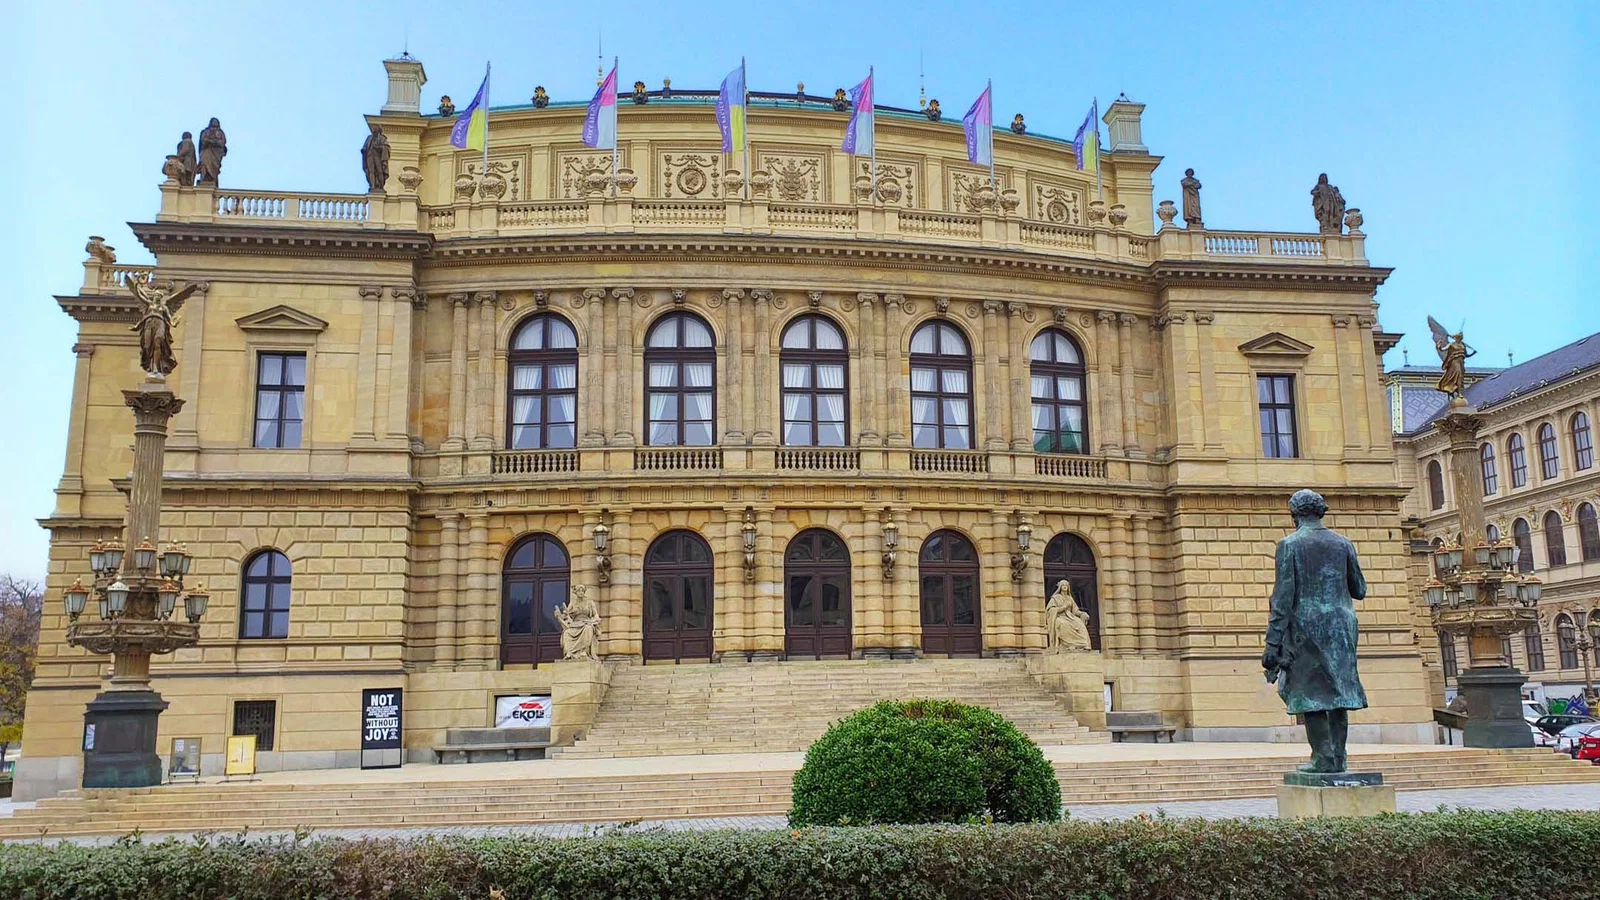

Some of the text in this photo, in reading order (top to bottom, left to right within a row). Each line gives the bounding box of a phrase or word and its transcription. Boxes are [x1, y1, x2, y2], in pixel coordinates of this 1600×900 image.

[371, 694, 394, 706] NOT
[366, 718, 398, 728] WITHOUT
[365, 729, 389, 741] JOY
